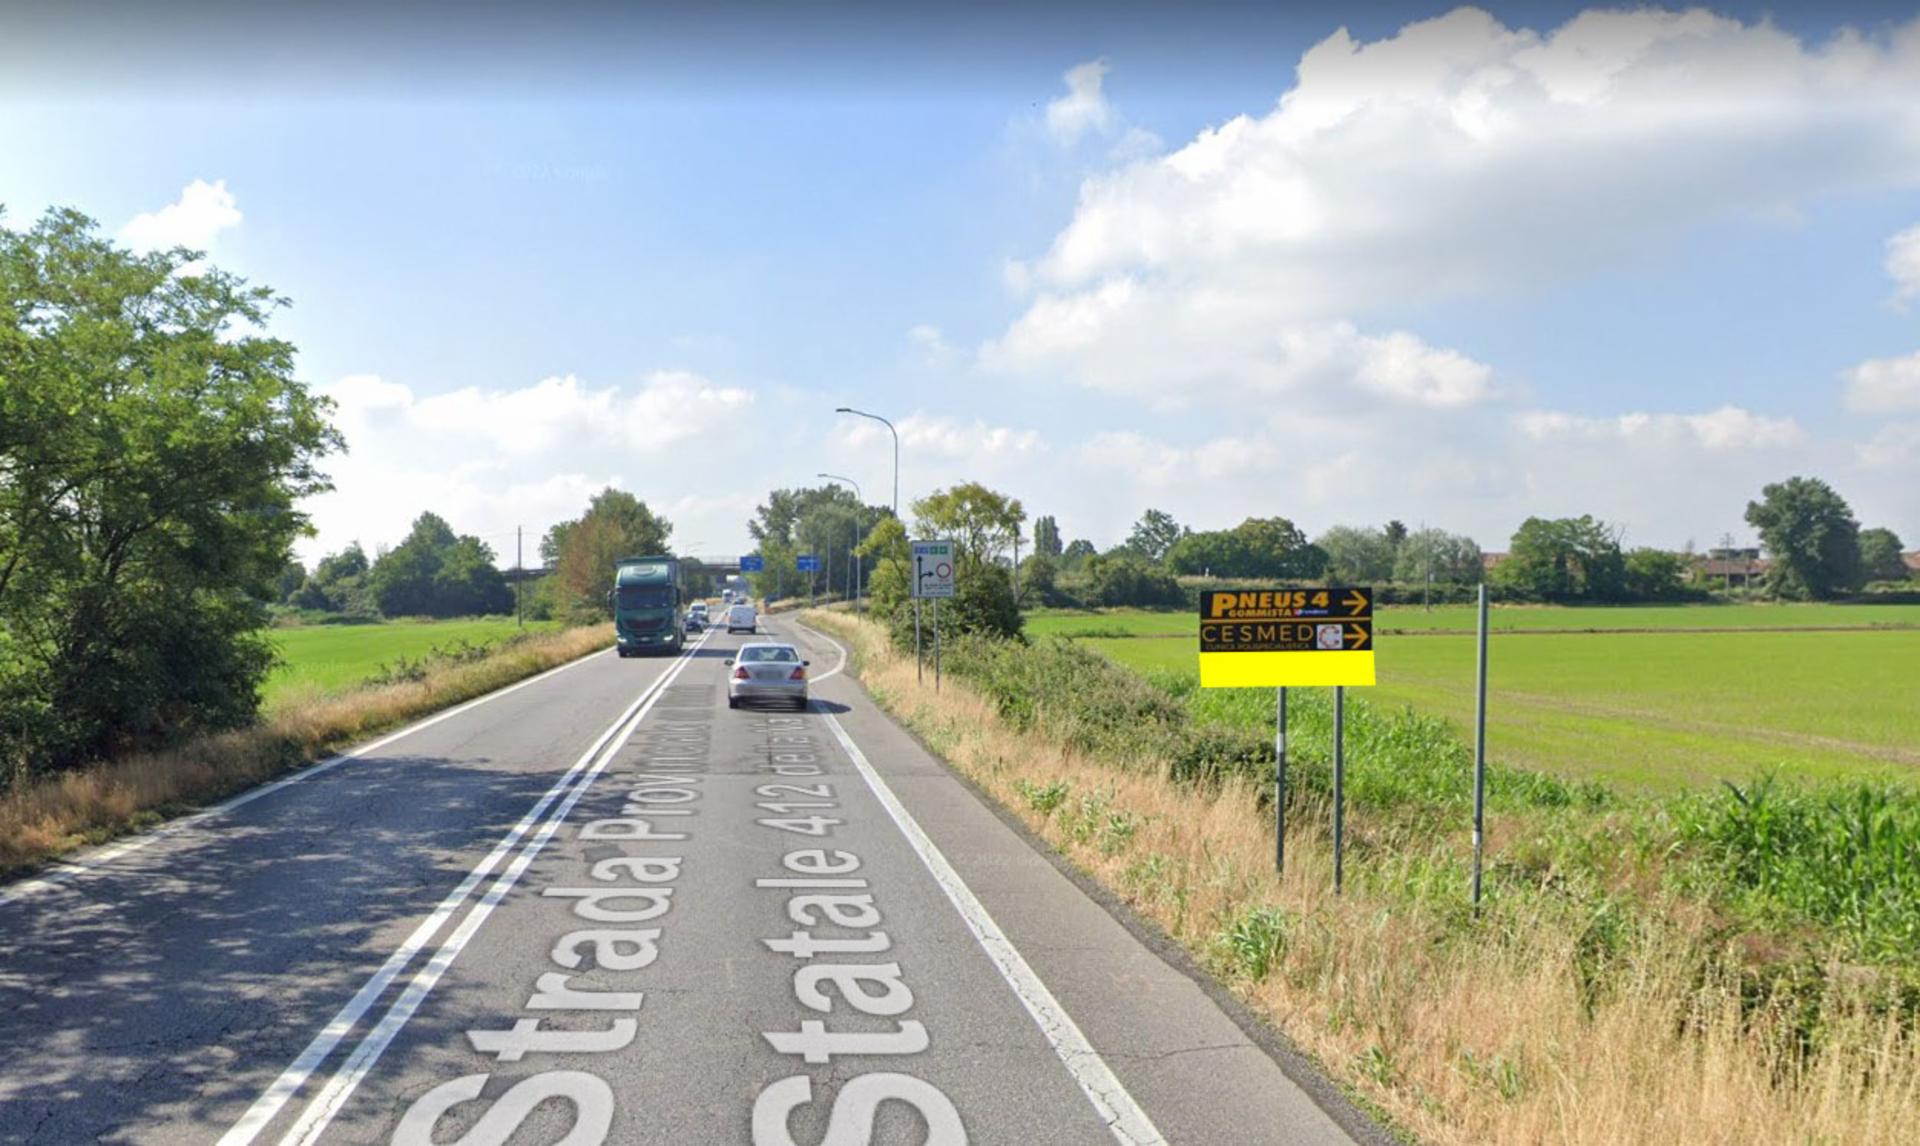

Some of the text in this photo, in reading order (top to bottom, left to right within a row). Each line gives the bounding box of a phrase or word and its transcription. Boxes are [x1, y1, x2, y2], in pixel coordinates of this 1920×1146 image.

[1211, 591, 1329, 617] PNEUS 4
[1228, 608, 1292, 618] GOMMISTA
[1202, 624, 1313, 642] CESMED
